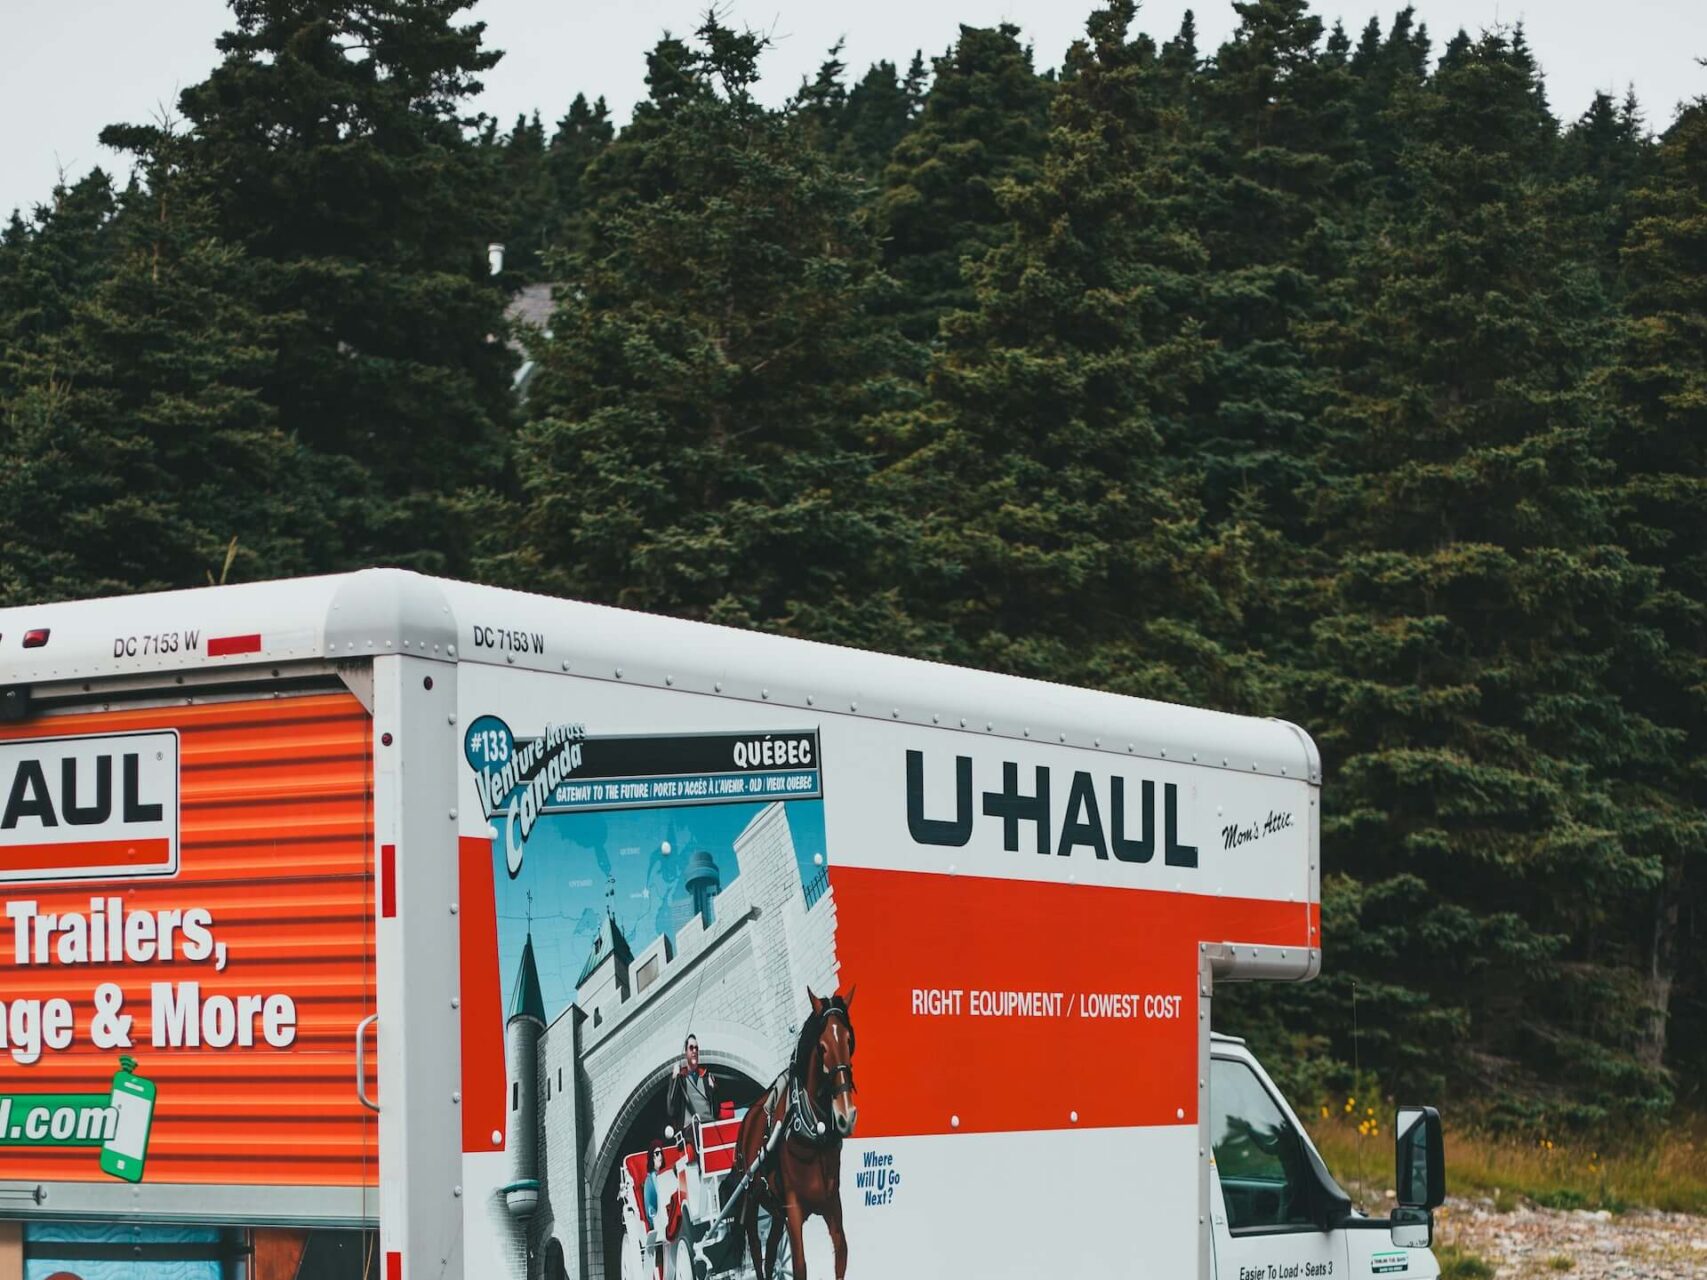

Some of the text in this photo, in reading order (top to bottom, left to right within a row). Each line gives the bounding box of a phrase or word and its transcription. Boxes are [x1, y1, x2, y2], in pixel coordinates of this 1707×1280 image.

[113, 629, 200, 658] DC 7153 W
[473, 625, 544, 655] DC 7153 W
[470, 730, 508, 762] #133
[733, 734, 812, 768] QUÉBEC
[475, 722, 588, 821] Venture Across
[556, 786, 592, 802] GATEWAY
[593, 785, 604, 800] TO
[605, 784, 620, 800] THE
[620, 783, 649, 799] FUTURE
[653, 781, 677, 797] PORTE
[715, 778, 745, 794] L'AVENIR
[749, 778, 763, 793] OLD
[766, 776, 786, 792] VIEUX
[505, 742, 583, 879] Canada
[906, 749, 1198, 868] U-HAUL
[1221, 821, 1259, 850] Mom's
[6, 897, 227, 970] Trailers,
[911, 989, 963, 1016] RIGHT
[970, 990, 1064, 1017] EQUIPMENT
[1080, 993, 1140, 1018] LOWEST
[1144, 994, 1182, 1019] COST
[0, 981, 297, 1064] ge & More
[863, 1150, 893, 1168] Where
[856, 1169, 900, 1190] Will U Go
[865, 1187, 894, 1206] Next?
[1240, 1261, 1333, 1280] Easier To Load Seats 3
